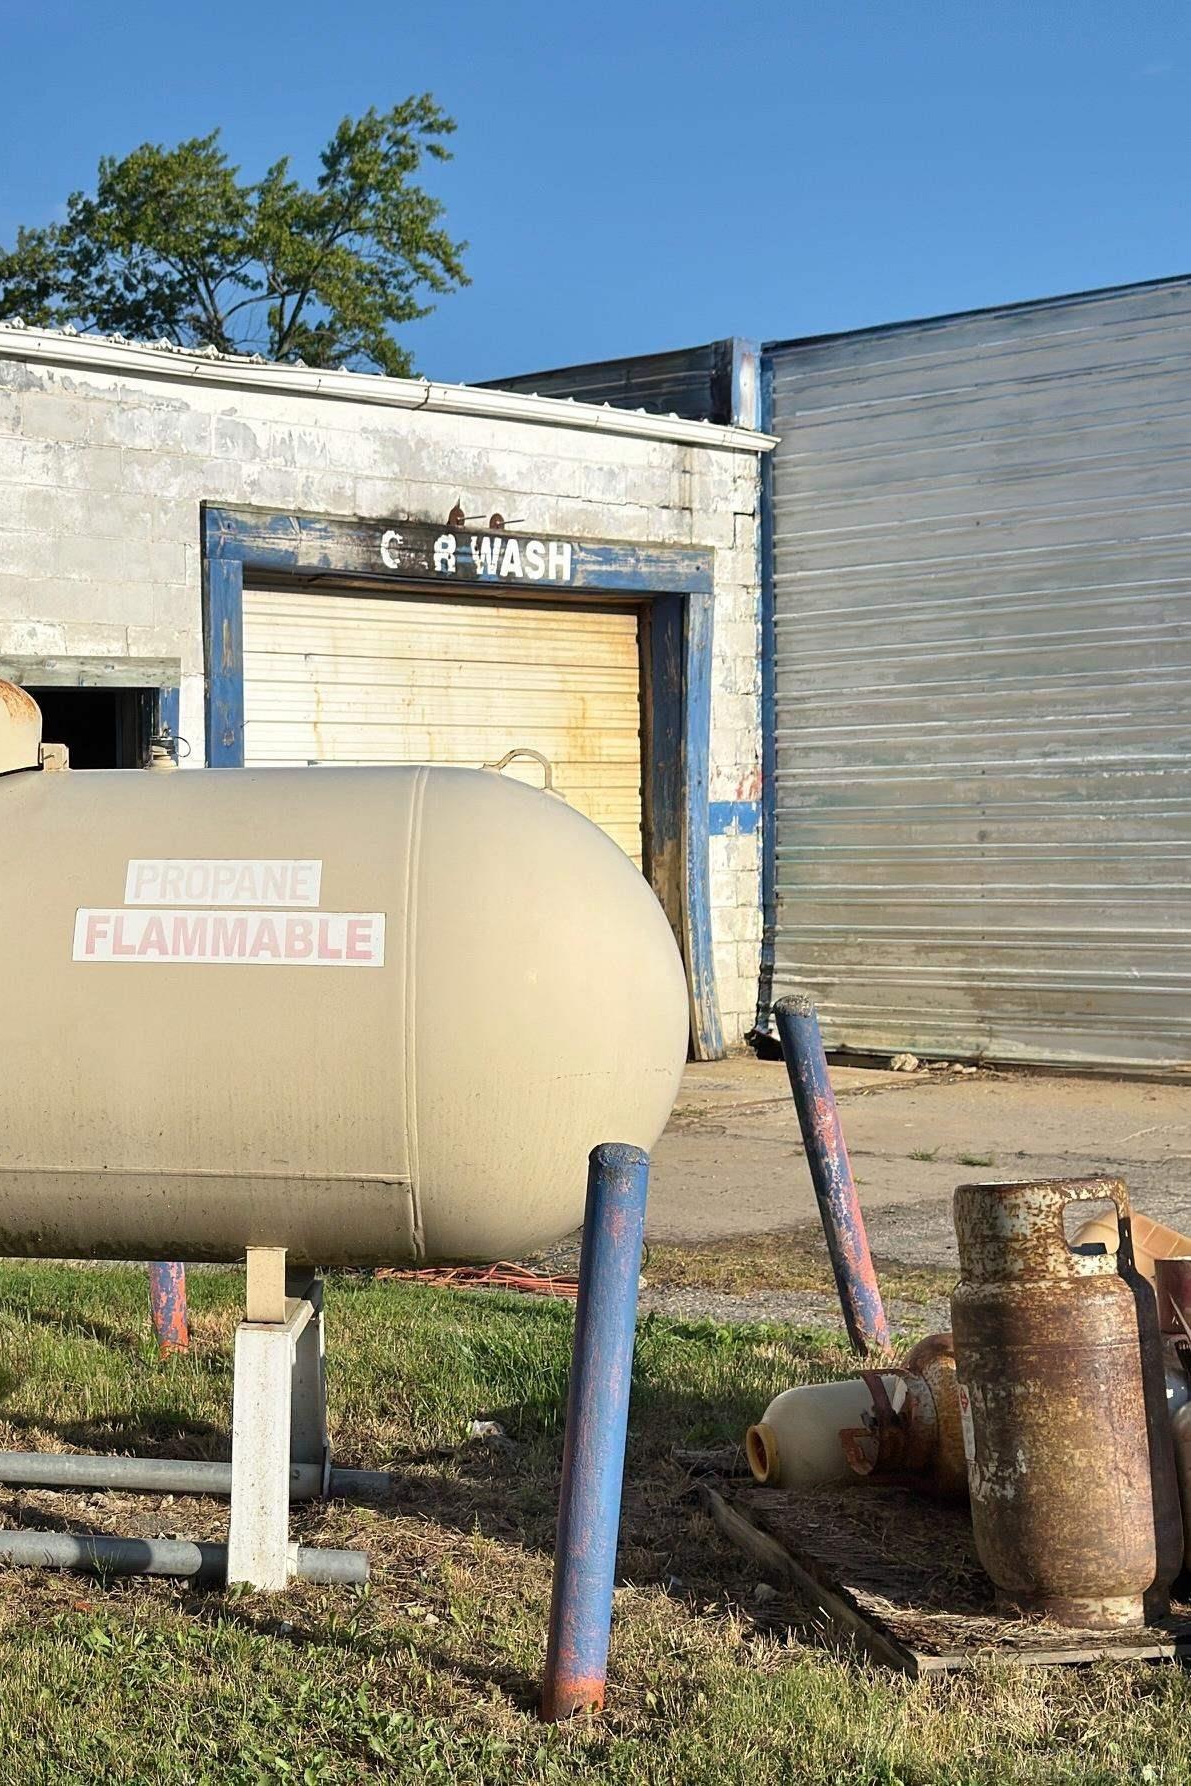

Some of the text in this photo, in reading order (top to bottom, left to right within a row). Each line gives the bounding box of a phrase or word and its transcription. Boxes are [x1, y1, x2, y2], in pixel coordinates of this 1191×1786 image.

[380, 530, 572, 581] CR WASH
[133, 863, 314, 902] PROPANE
[84, 914, 373, 960] FLAMMABLE
